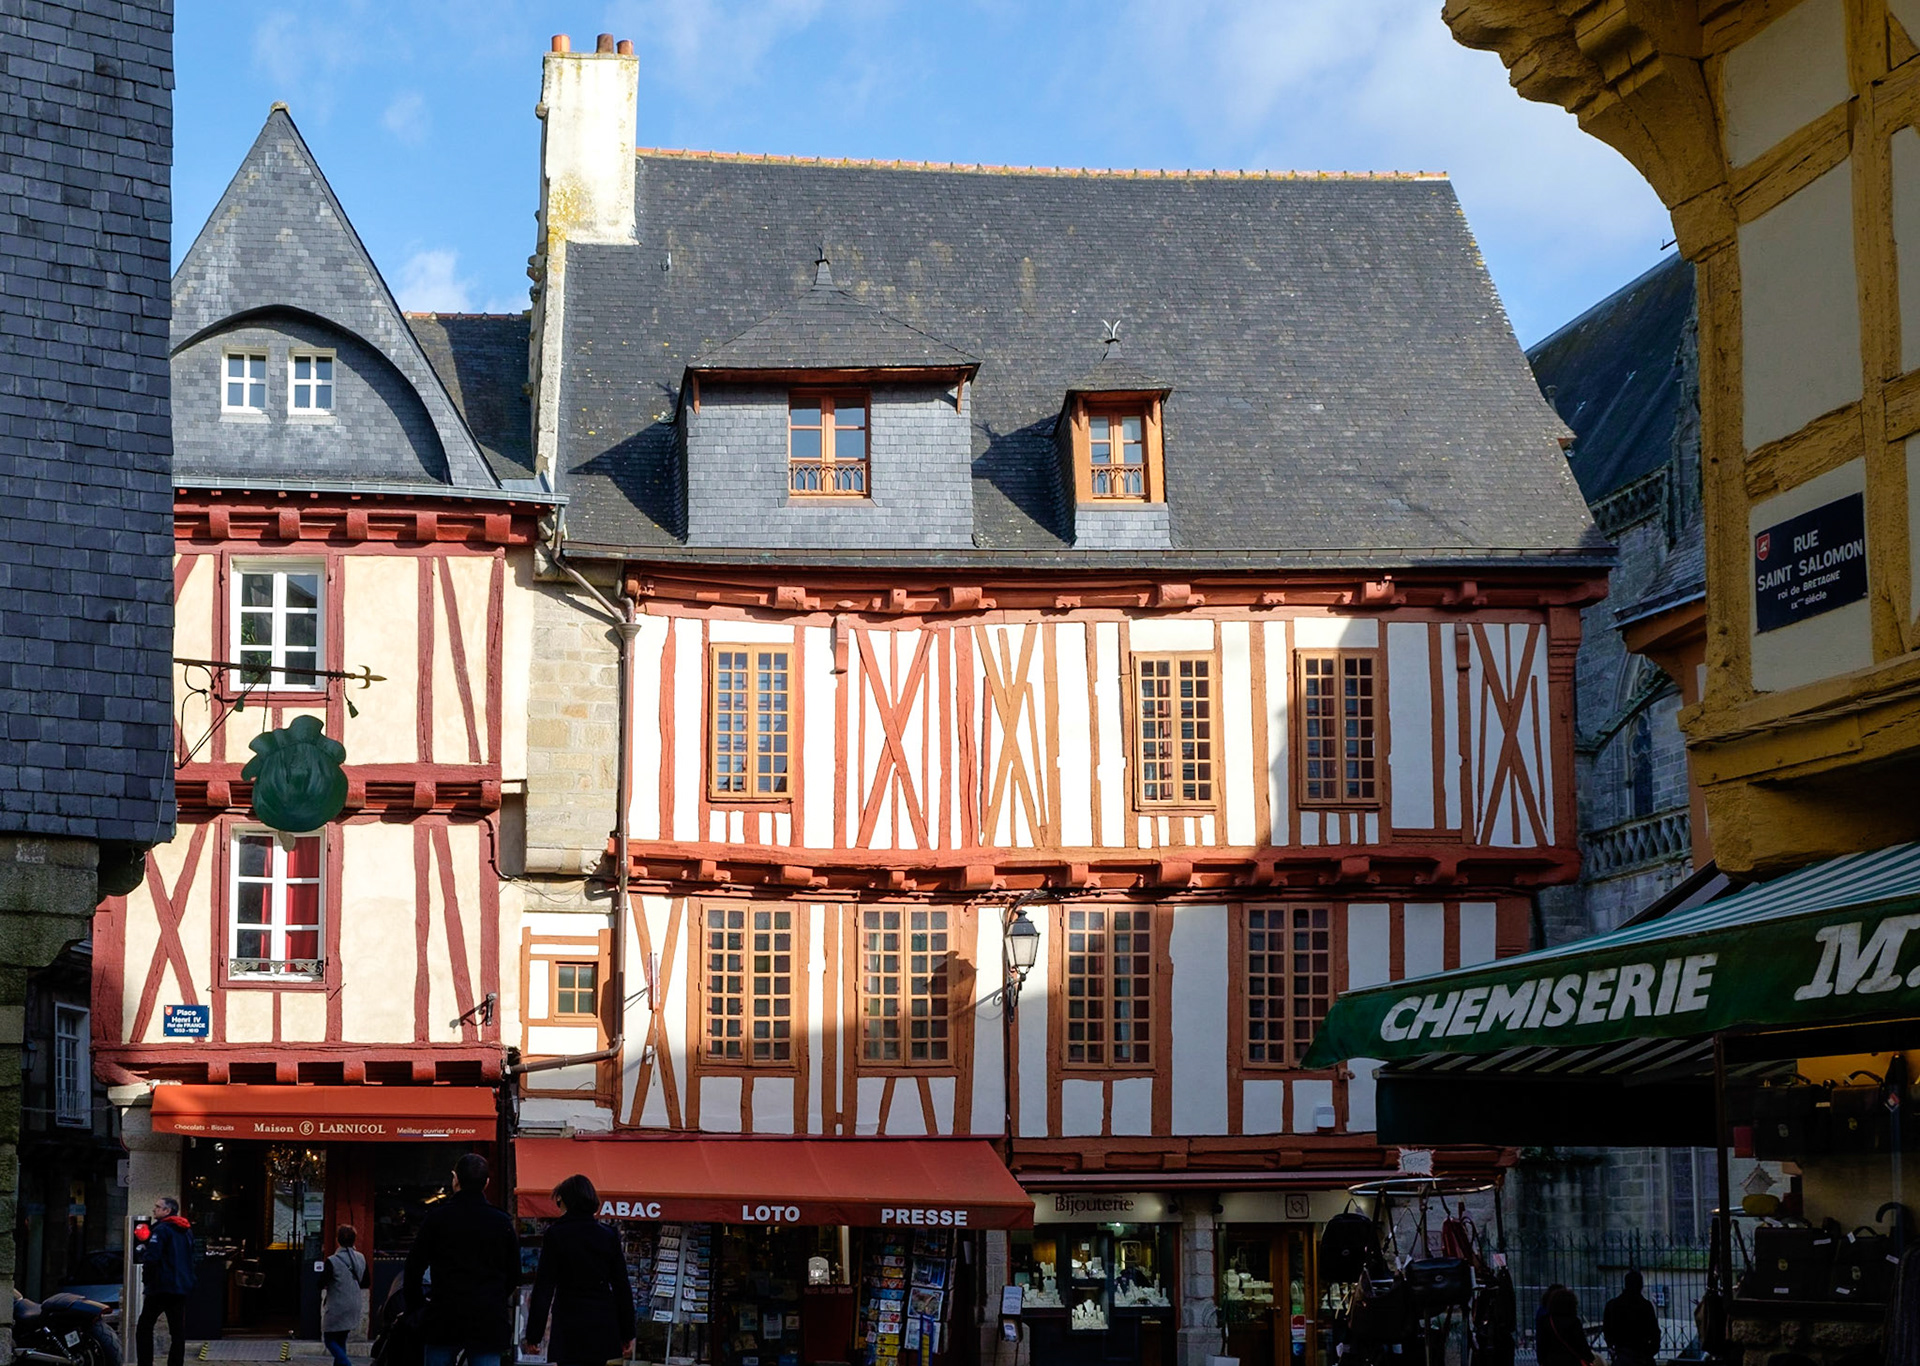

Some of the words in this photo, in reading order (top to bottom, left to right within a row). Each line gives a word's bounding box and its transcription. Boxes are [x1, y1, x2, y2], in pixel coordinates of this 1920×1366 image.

[1793, 529, 1819, 554] RUE
[1757, 564, 1793, 592] SAINT
[1798, 538, 1864, 577] SALOMON
[1777, 588, 1788, 600] roi
[1790, 585, 1801, 596] de
[1802, 569, 1841, 592] BRETAGNE
[1380, 952, 1719, 1043] CHEMISERIE
[174, 1123, 205, 1131] Chocolats
[254, 1122, 294, 1133] Maison
[319, 1122, 387, 1134] LARNICOL
[599, 1200, 661, 1218] ABAC
[742, 1205, 800, 1222] LOTO
[881, 1208, 968, 1226] PRESSE
[1055, 1195, 1134, 1216] Bijouterie
